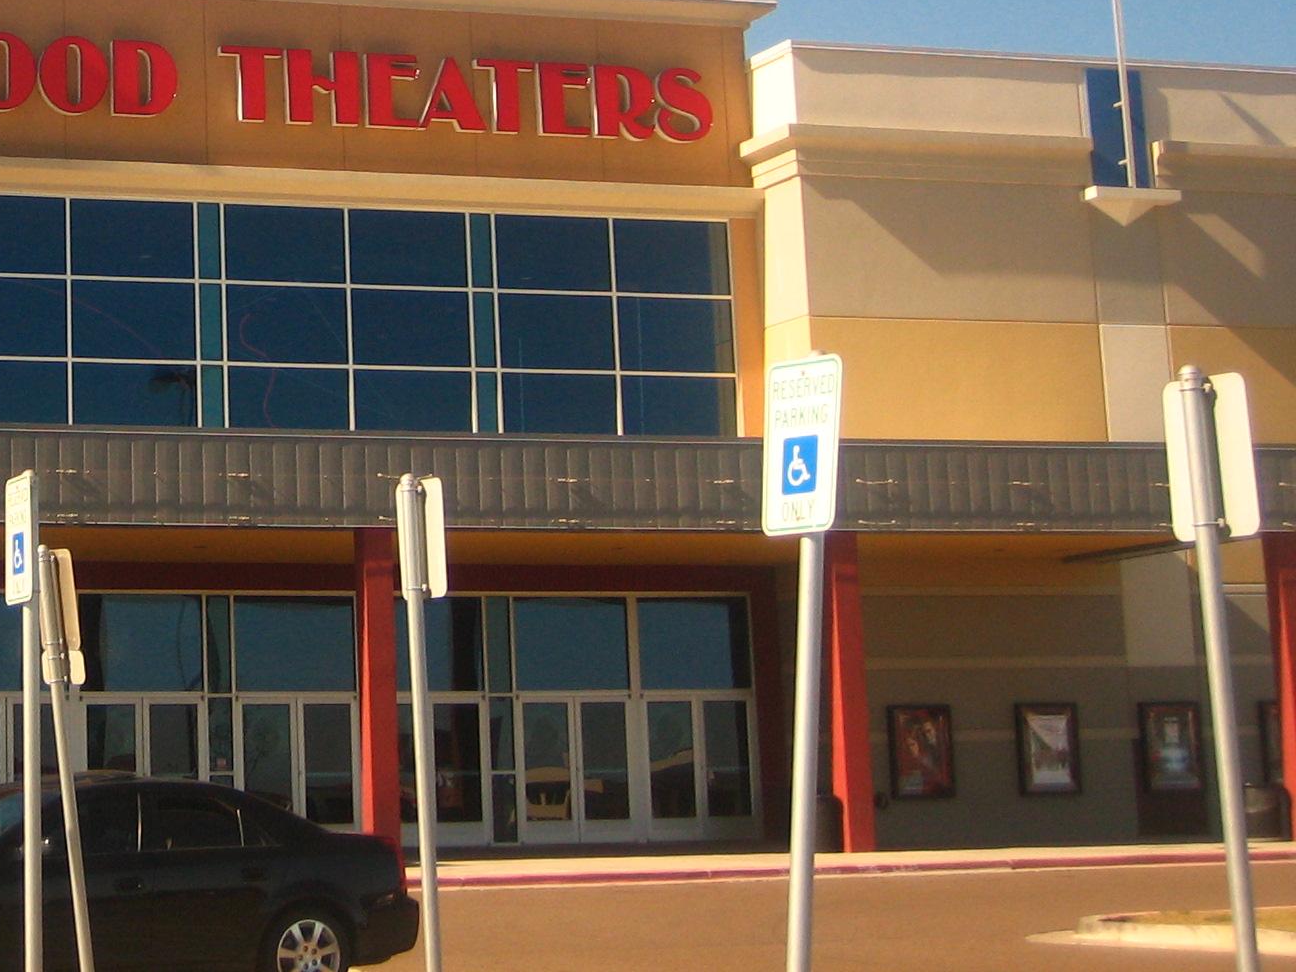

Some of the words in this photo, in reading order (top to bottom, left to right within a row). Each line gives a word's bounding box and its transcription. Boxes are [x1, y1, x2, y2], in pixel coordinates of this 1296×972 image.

[217, 45, 713, 143] THEATERS
[773, 373, 834, 400] RESERVED
[775, 403, 828, 429] PARKING
[782, 498, 816, 522] ONLY
